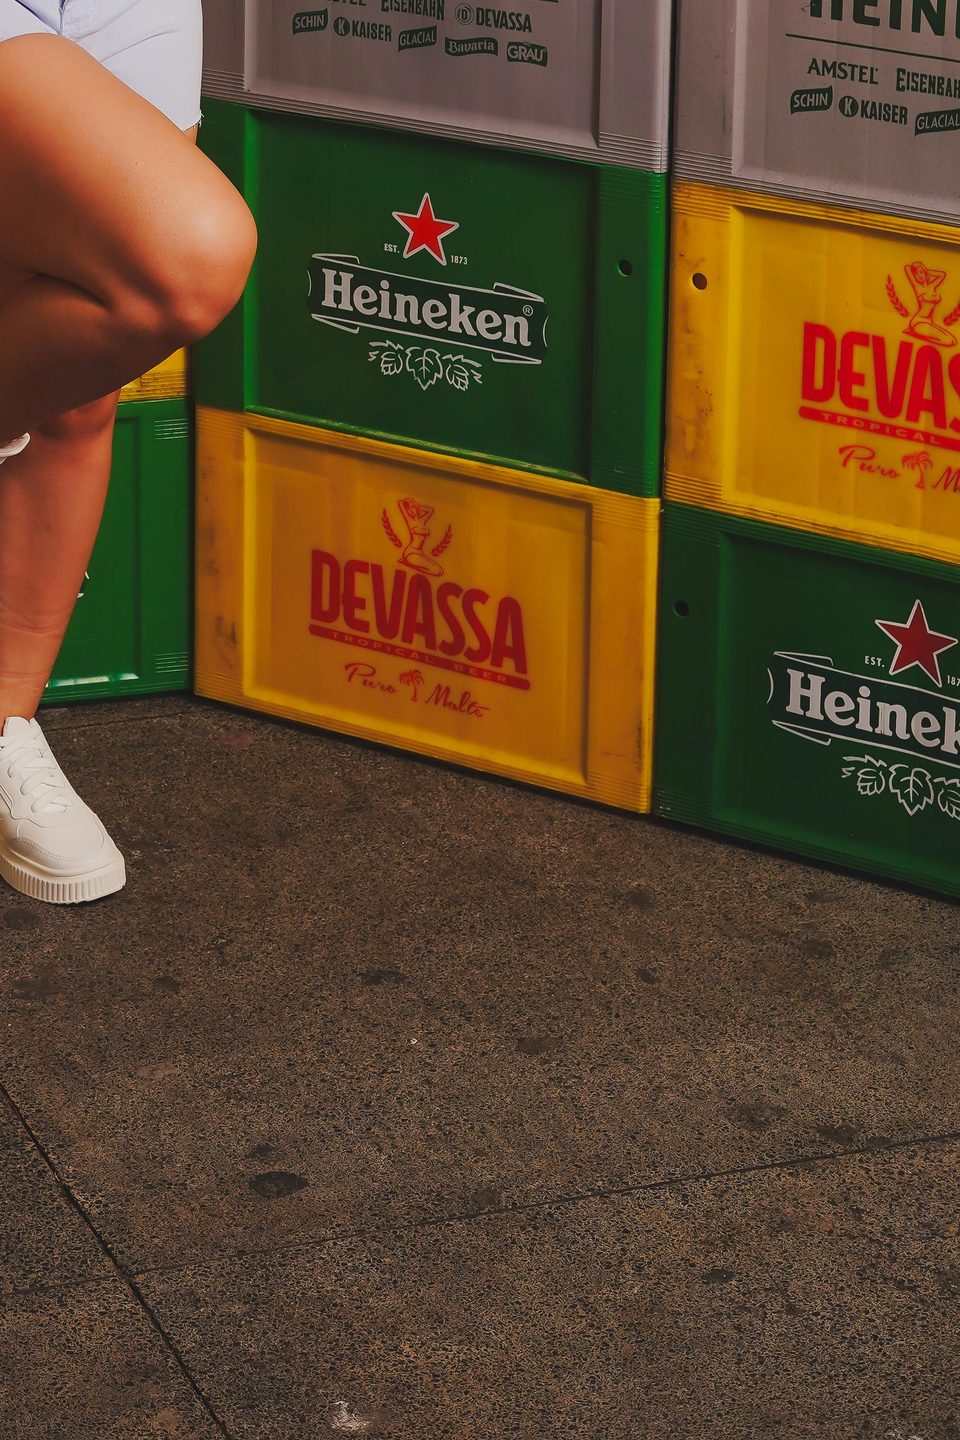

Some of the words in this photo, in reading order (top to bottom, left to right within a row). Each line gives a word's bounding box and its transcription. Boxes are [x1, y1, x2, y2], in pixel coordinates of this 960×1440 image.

[295, 14, 325, 29] SCHIN
[352, 19, 391, 42] KAISER
[400, 29, 436, 47] GLACIAL
[448, 39, 494, 54] Bavaria
[507, 45, 544, 62] GRAU
[476, 7, 532, 33] DEVASSA
[807, 57, 879, 85] AMSTEL
[793, 91, 829, 108] SCHIN
[860, 99, 908, 125] KAISER
[916, 113, 960, 130] GLACIAL
[384, 243, 400, 254] EST.
[450, 255, 468, 265] 1873
[321, 268, 531, 347] Heineken
[822, 411, 941, 446] TROPICAL
[838, 444, 901, 479] Puro
[310, 549, 528, 675] DEVASSA
[332, 631, 434, 664] TROPICAL
[454, 664, 507, 683] BEER
[864, 655, 885, 668] EST.
[344, 662, 398, 695] Puro
[425, 684, 490, 718] Malte
